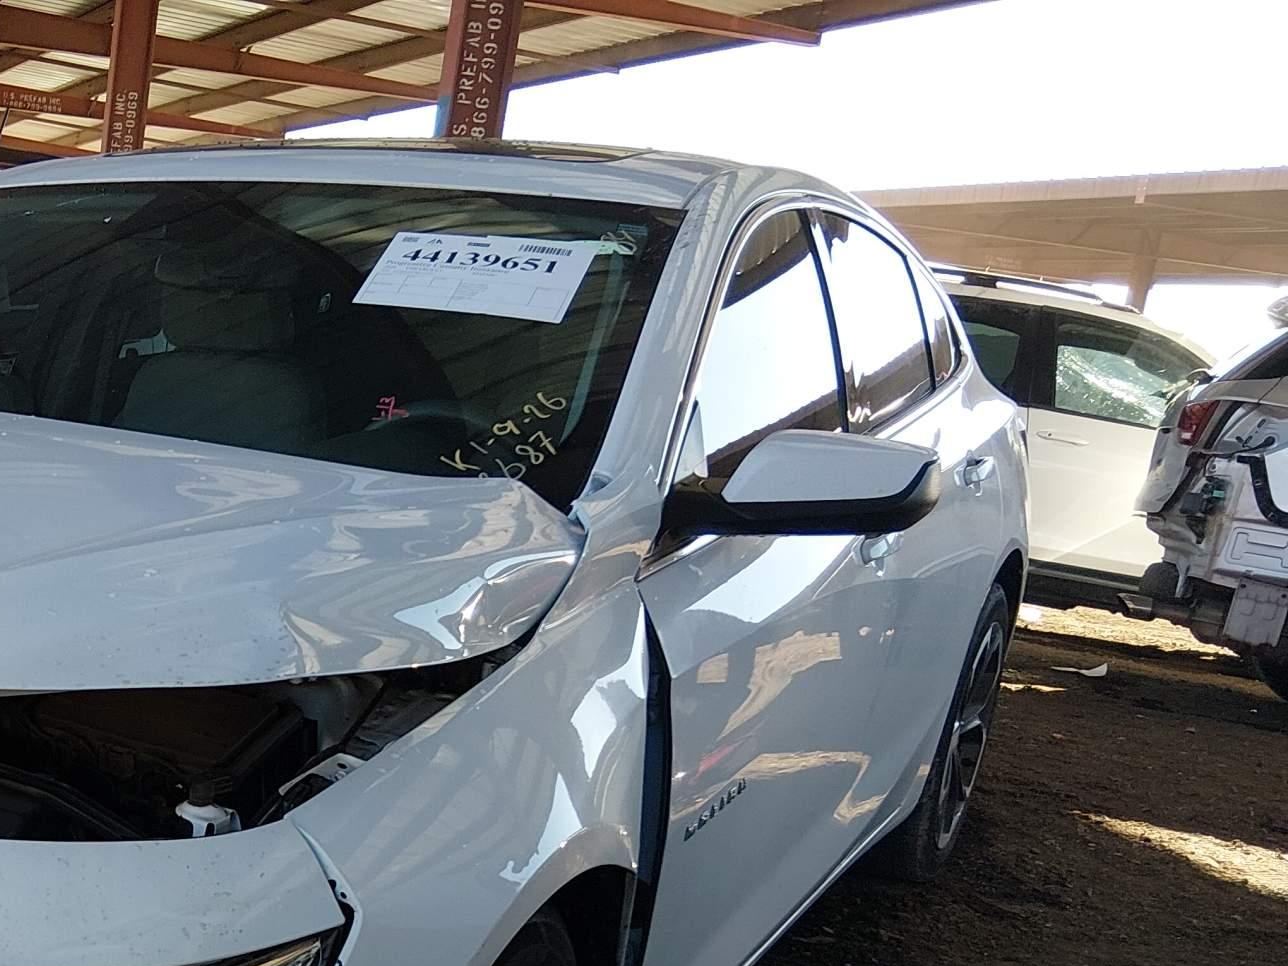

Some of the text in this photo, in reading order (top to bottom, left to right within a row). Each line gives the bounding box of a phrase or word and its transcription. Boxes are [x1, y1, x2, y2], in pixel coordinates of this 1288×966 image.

[457, 21, 482, 104] PREFAB
[114, 89, 127, 115] INC.
[402, 248, 558, 274] 44139651
